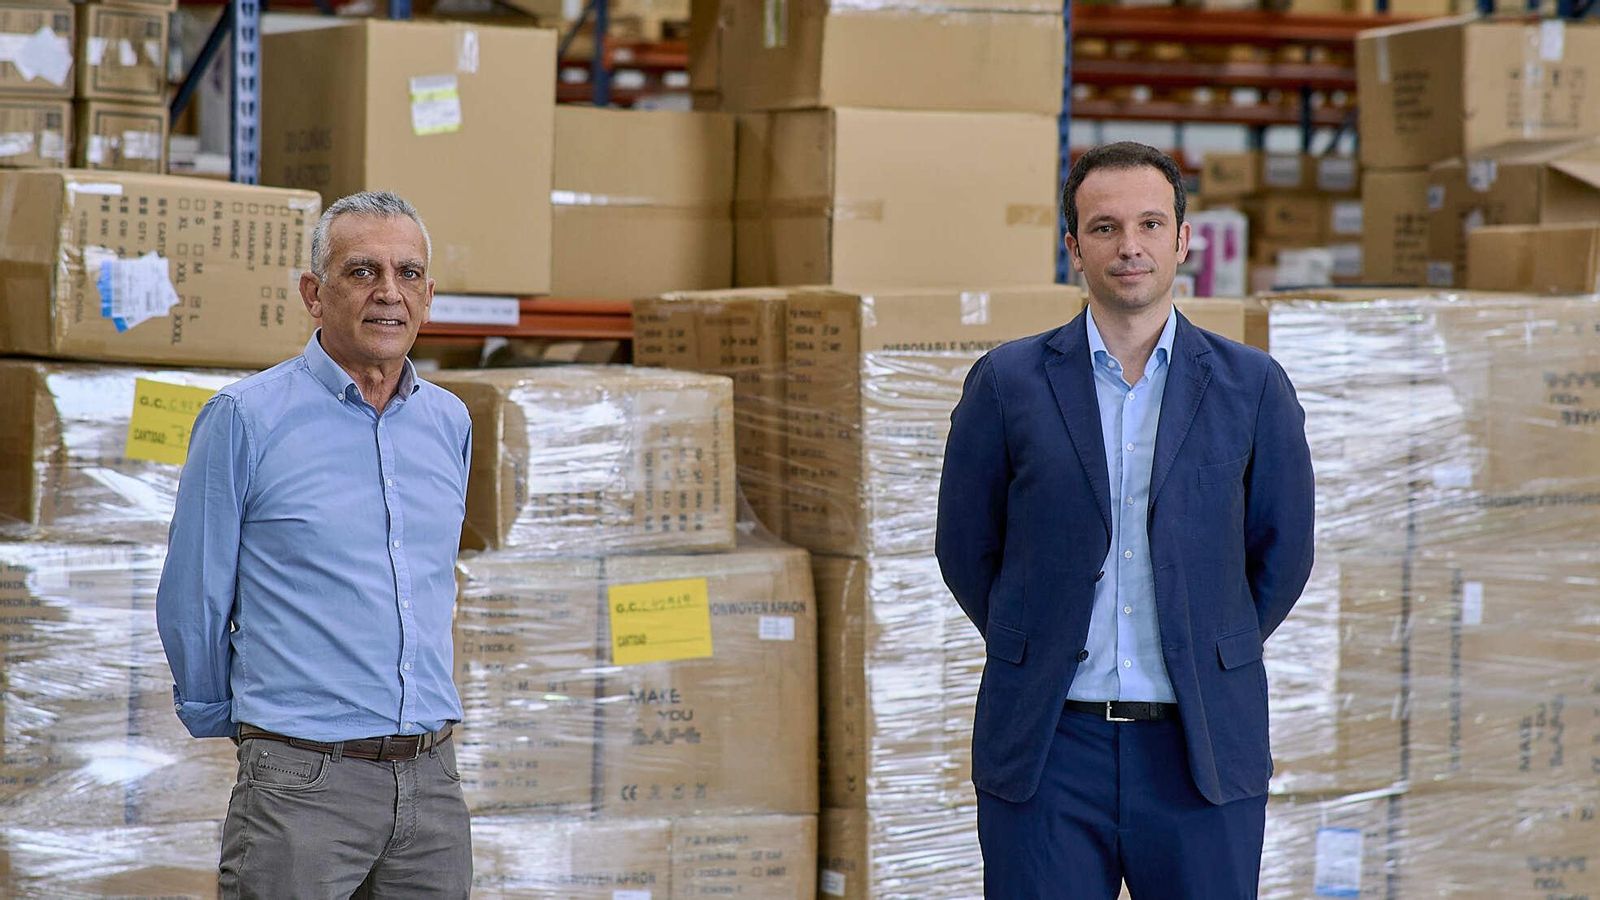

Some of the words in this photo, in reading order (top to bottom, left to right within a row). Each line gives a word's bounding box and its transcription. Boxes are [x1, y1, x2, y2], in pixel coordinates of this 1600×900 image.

[178, 216, 188, 231] XL
[176, 263, 187, 284] XXL
[194, 262, 203, 274] M
[172, 315, 183, 345] XXXL
[770, 601, 806, 614] APRON
[628, 688, 681, 704] MAKE
[657, 709, 694, 721] YOU
